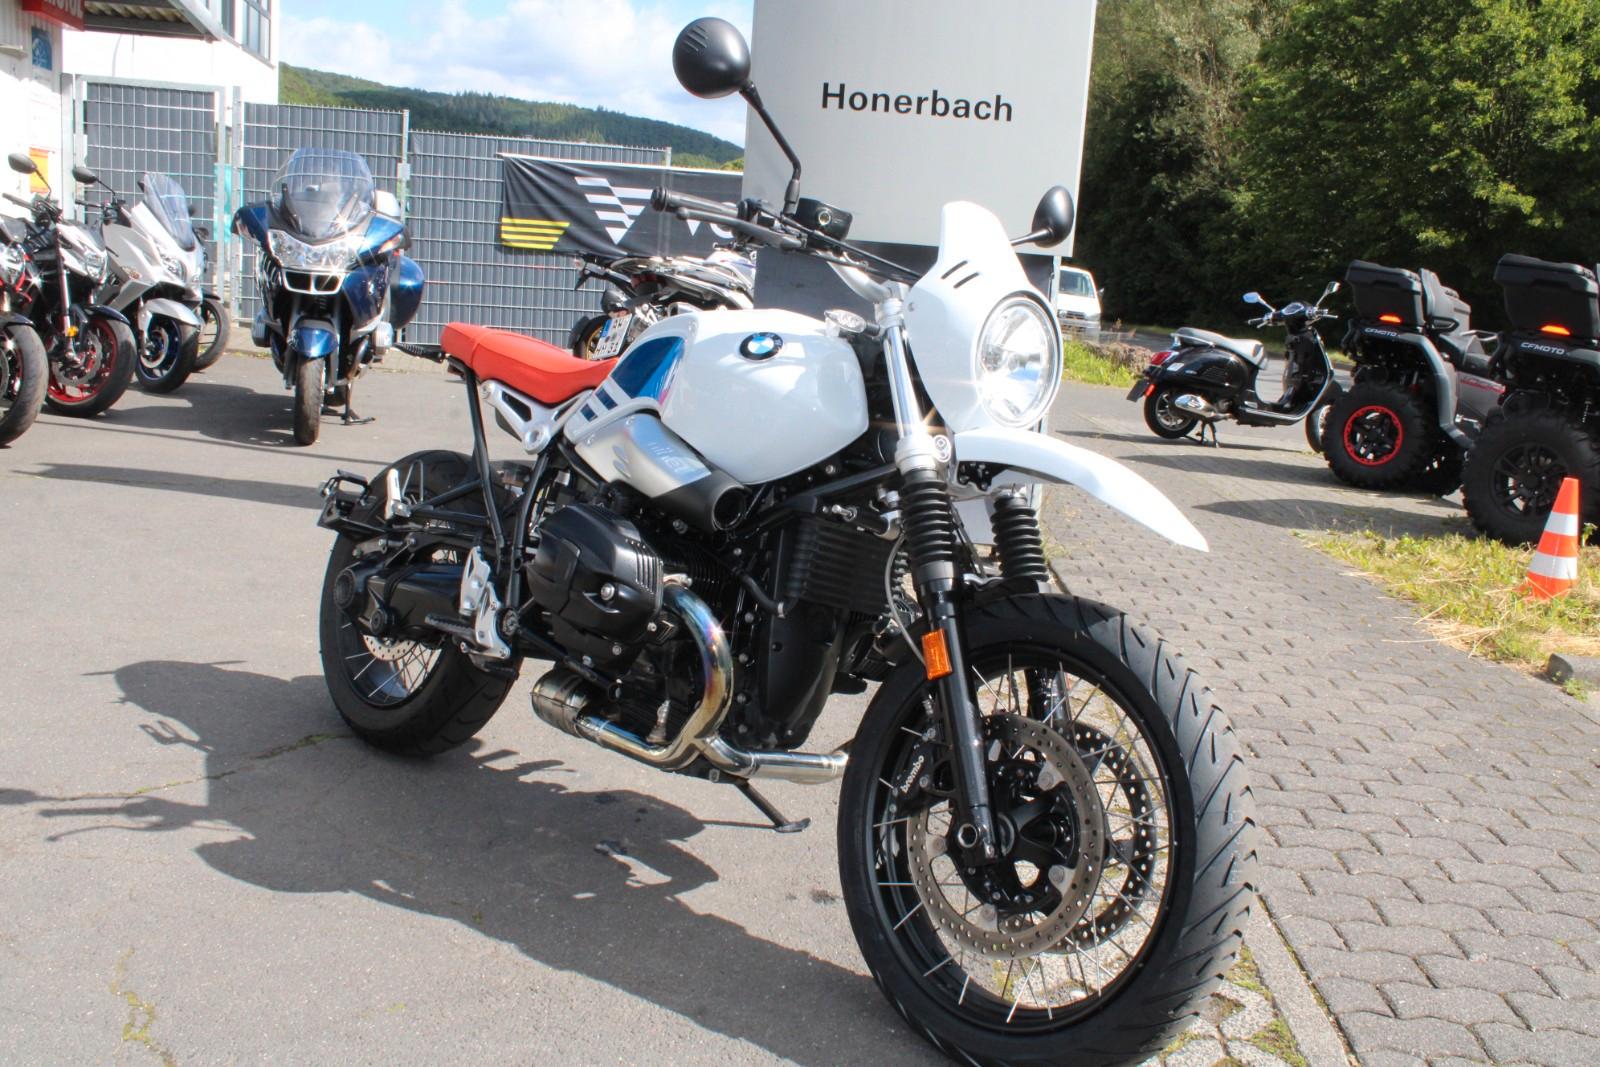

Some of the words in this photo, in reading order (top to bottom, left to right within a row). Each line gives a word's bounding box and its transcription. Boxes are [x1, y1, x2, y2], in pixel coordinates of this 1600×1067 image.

[821, 82, 1013, 122] Honerbach
[1364, 327, 1398, 337] CFMOTO
[1520, 342, 1565, 355] CFMOTO
[900, 755, 924, 793] brembo
